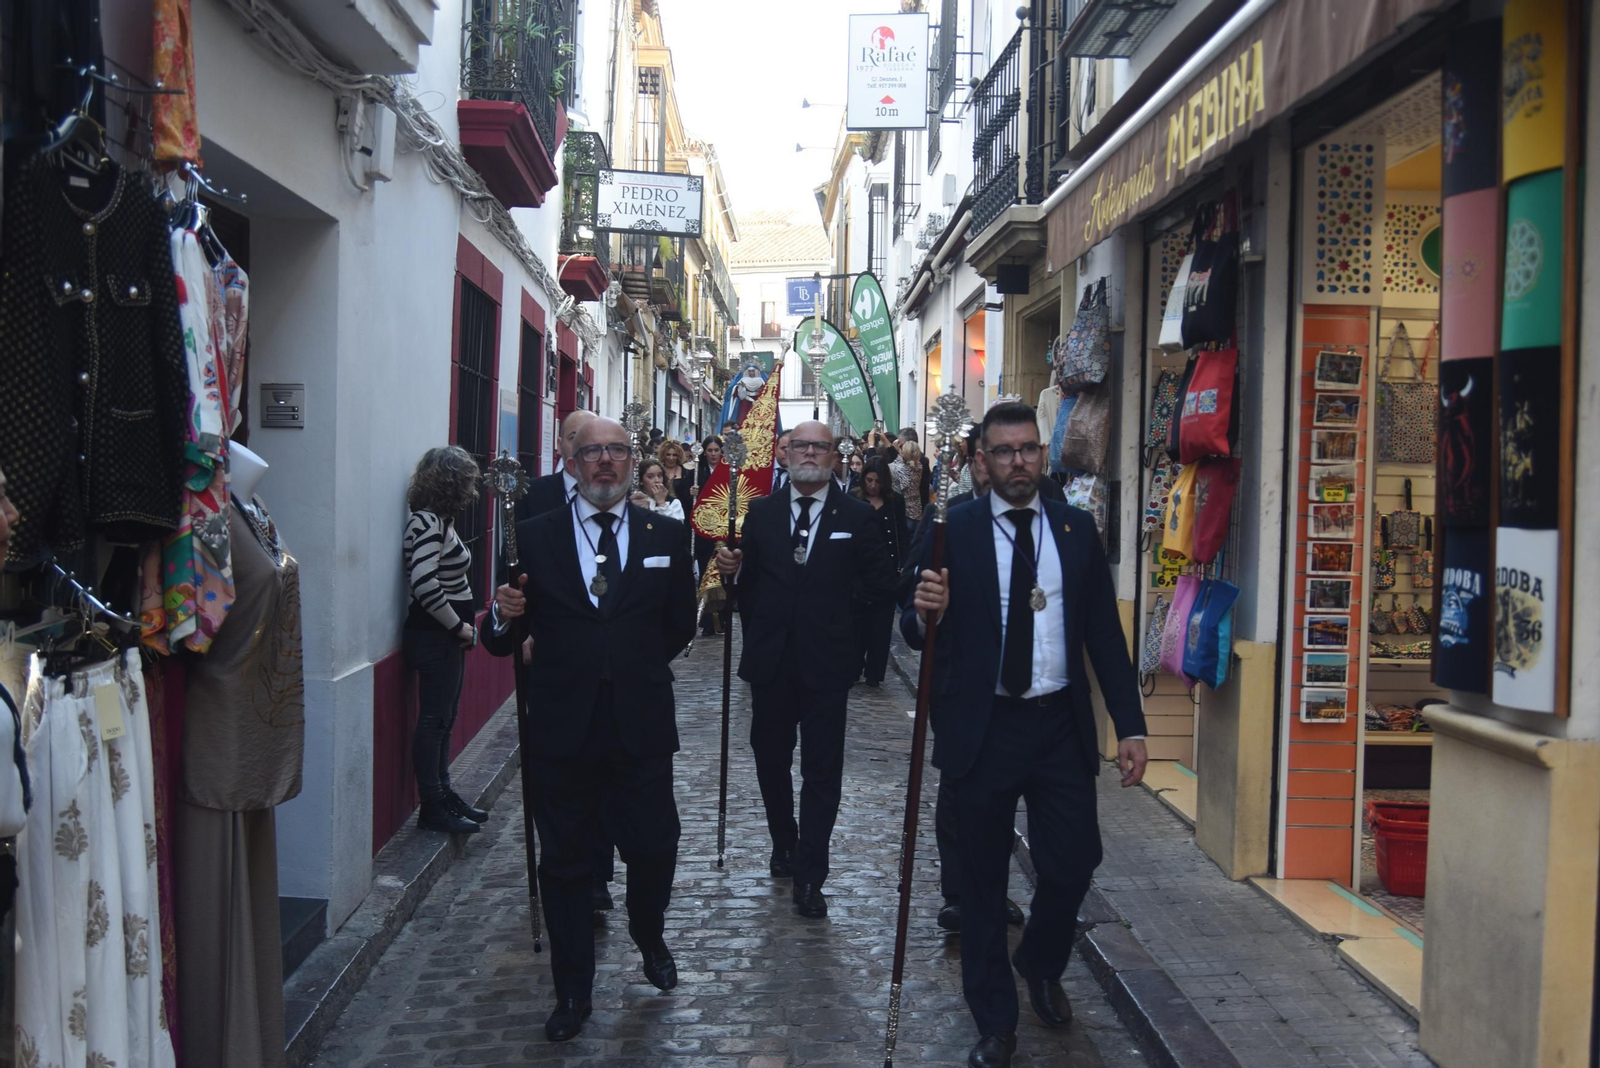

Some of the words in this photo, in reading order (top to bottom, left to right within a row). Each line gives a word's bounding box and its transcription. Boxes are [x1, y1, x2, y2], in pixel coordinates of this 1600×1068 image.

[861, 46, 917, 68] Rafaé
[1165, 39, 1266, 182] MEDINA
[627, 174, 676, 185] TABERNA
[621, 186, 679, 203] PEDRO
[612, 201, 686, 219] XIMÉNEZ
[793, 285, 810, 301] TB
[831, 377, 861, 392] NUEVO
[834, 386, 863, 401] SUPER
